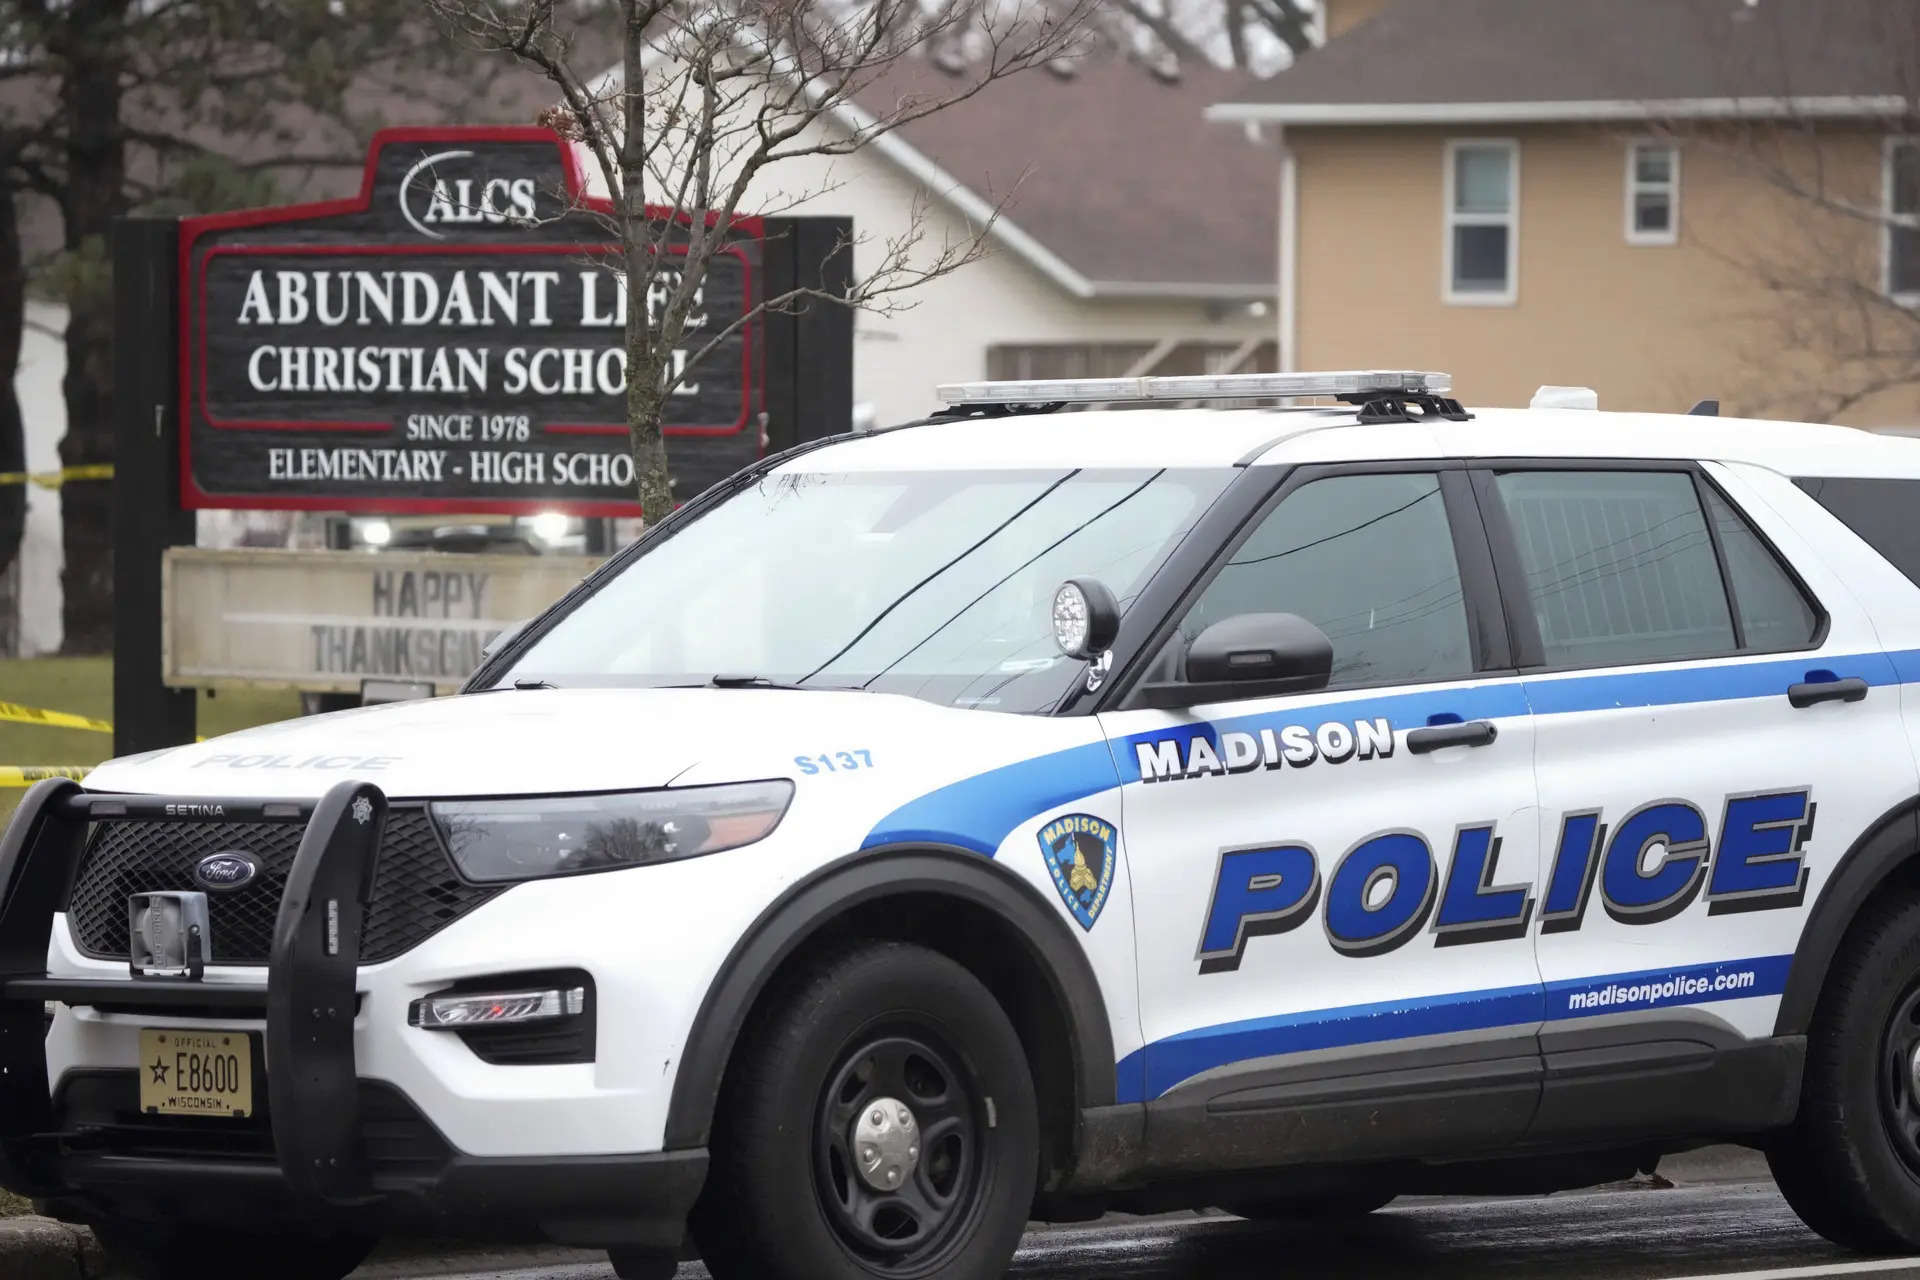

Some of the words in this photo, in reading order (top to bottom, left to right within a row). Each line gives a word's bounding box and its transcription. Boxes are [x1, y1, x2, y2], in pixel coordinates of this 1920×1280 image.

[423, 178, 537, 225] ALCS
[238, 270, 561, 326] ABUNDANT
[248, 345, 489, 393] CHRISTIAN
[503, 347, 700, 396] SCHOL
[407, 414, 473, 441] SINCE
[481, 415, 530, 442] 1978
[268, 448, 447, 481] ELEMENTARY
[470, 451, 545, 485] HIGH
[553, 452, 677, 486] SCHO
[373, 570, 489, 620] HAPPY
[191, 754, 403, 770] POLICE
[793, 748, 875, 776] S137
[1134, 717, 1396, 783] MADISON
[165, 804, 225, 818] SETINA
[1043, 817, 1110, 846] MADISON
[1049, 857, 1080, 911] POLICE
[1087, 845, 1113, 919] DEPARTMENT
[1195, 785, 1816, 974] POLICE
[1569, 970, 1755, 1010] madisonpolice.com
[174, 1036, 217, 1049] OFFICIAL
[175, 1052, 239, 1093] E8600
[168, 1096, 223, 1110] WISCONSIN
